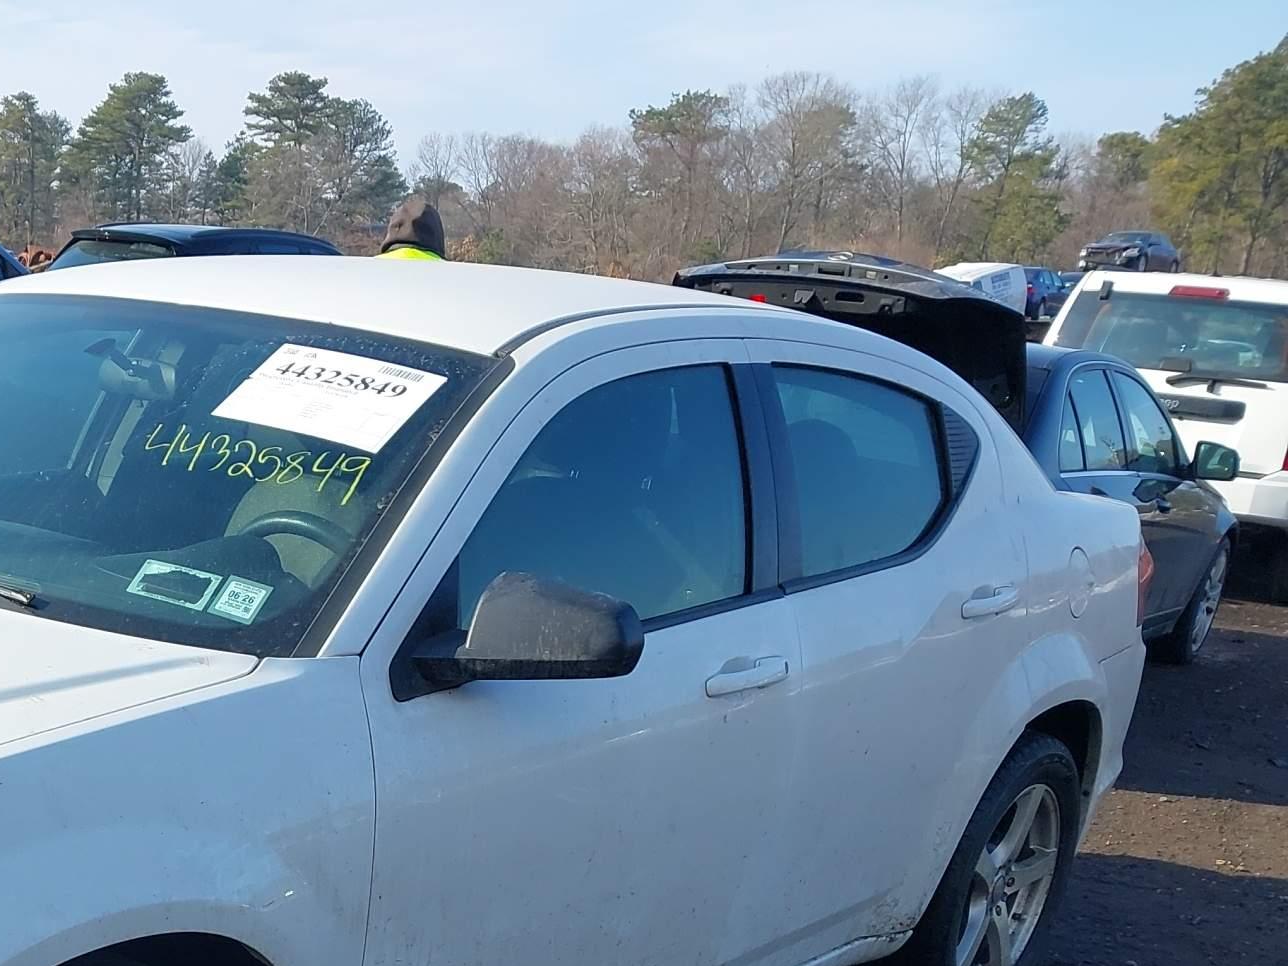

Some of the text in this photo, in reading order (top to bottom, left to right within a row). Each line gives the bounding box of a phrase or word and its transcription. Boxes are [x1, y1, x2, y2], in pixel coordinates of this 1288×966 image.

[276, 362, 408, 398] 44325849
[145, 424, 372, 506] 44325849
[228, 590, 255, 604] 06 26
